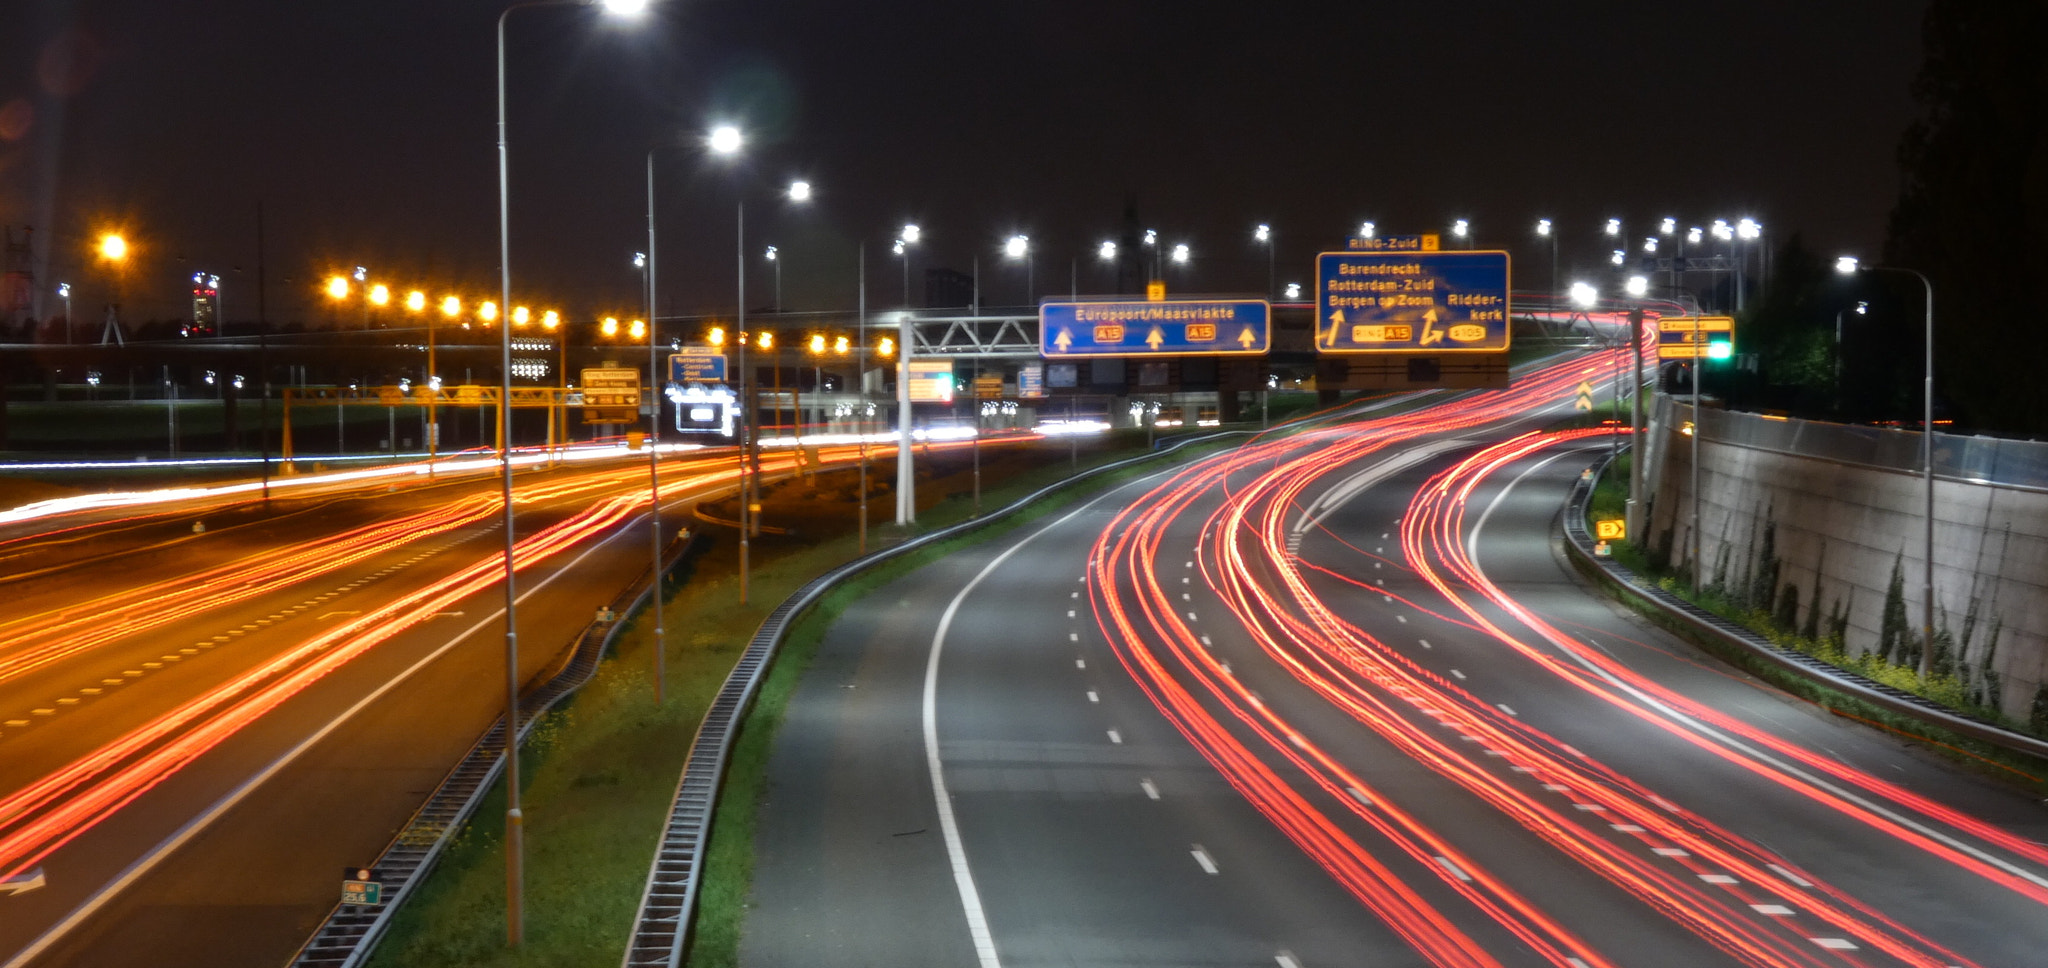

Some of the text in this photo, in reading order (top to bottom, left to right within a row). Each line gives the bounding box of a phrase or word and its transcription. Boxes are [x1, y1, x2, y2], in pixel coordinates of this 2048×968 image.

[1349, 238, 1418, 249] RING-Zuid
[1339, 263, 1421, 275] Barendrecht
[1328, 279, 1435, 292] Rotterdam-Zuid
[1328, 295, 1376, 309] Bergen
[1397, 294, 1434, 307] Zoom
[1447, 293, 1503, 306] Ridder-
[1075, 308, 1235, 322] Europoort/Maasvlakte
[1469, 309, 1503, 321] kerk
[1096, 327, 1121, 340] A15
[1188, 326, 1213, 338] A15
[1385, 328, 1409, 338] A15
